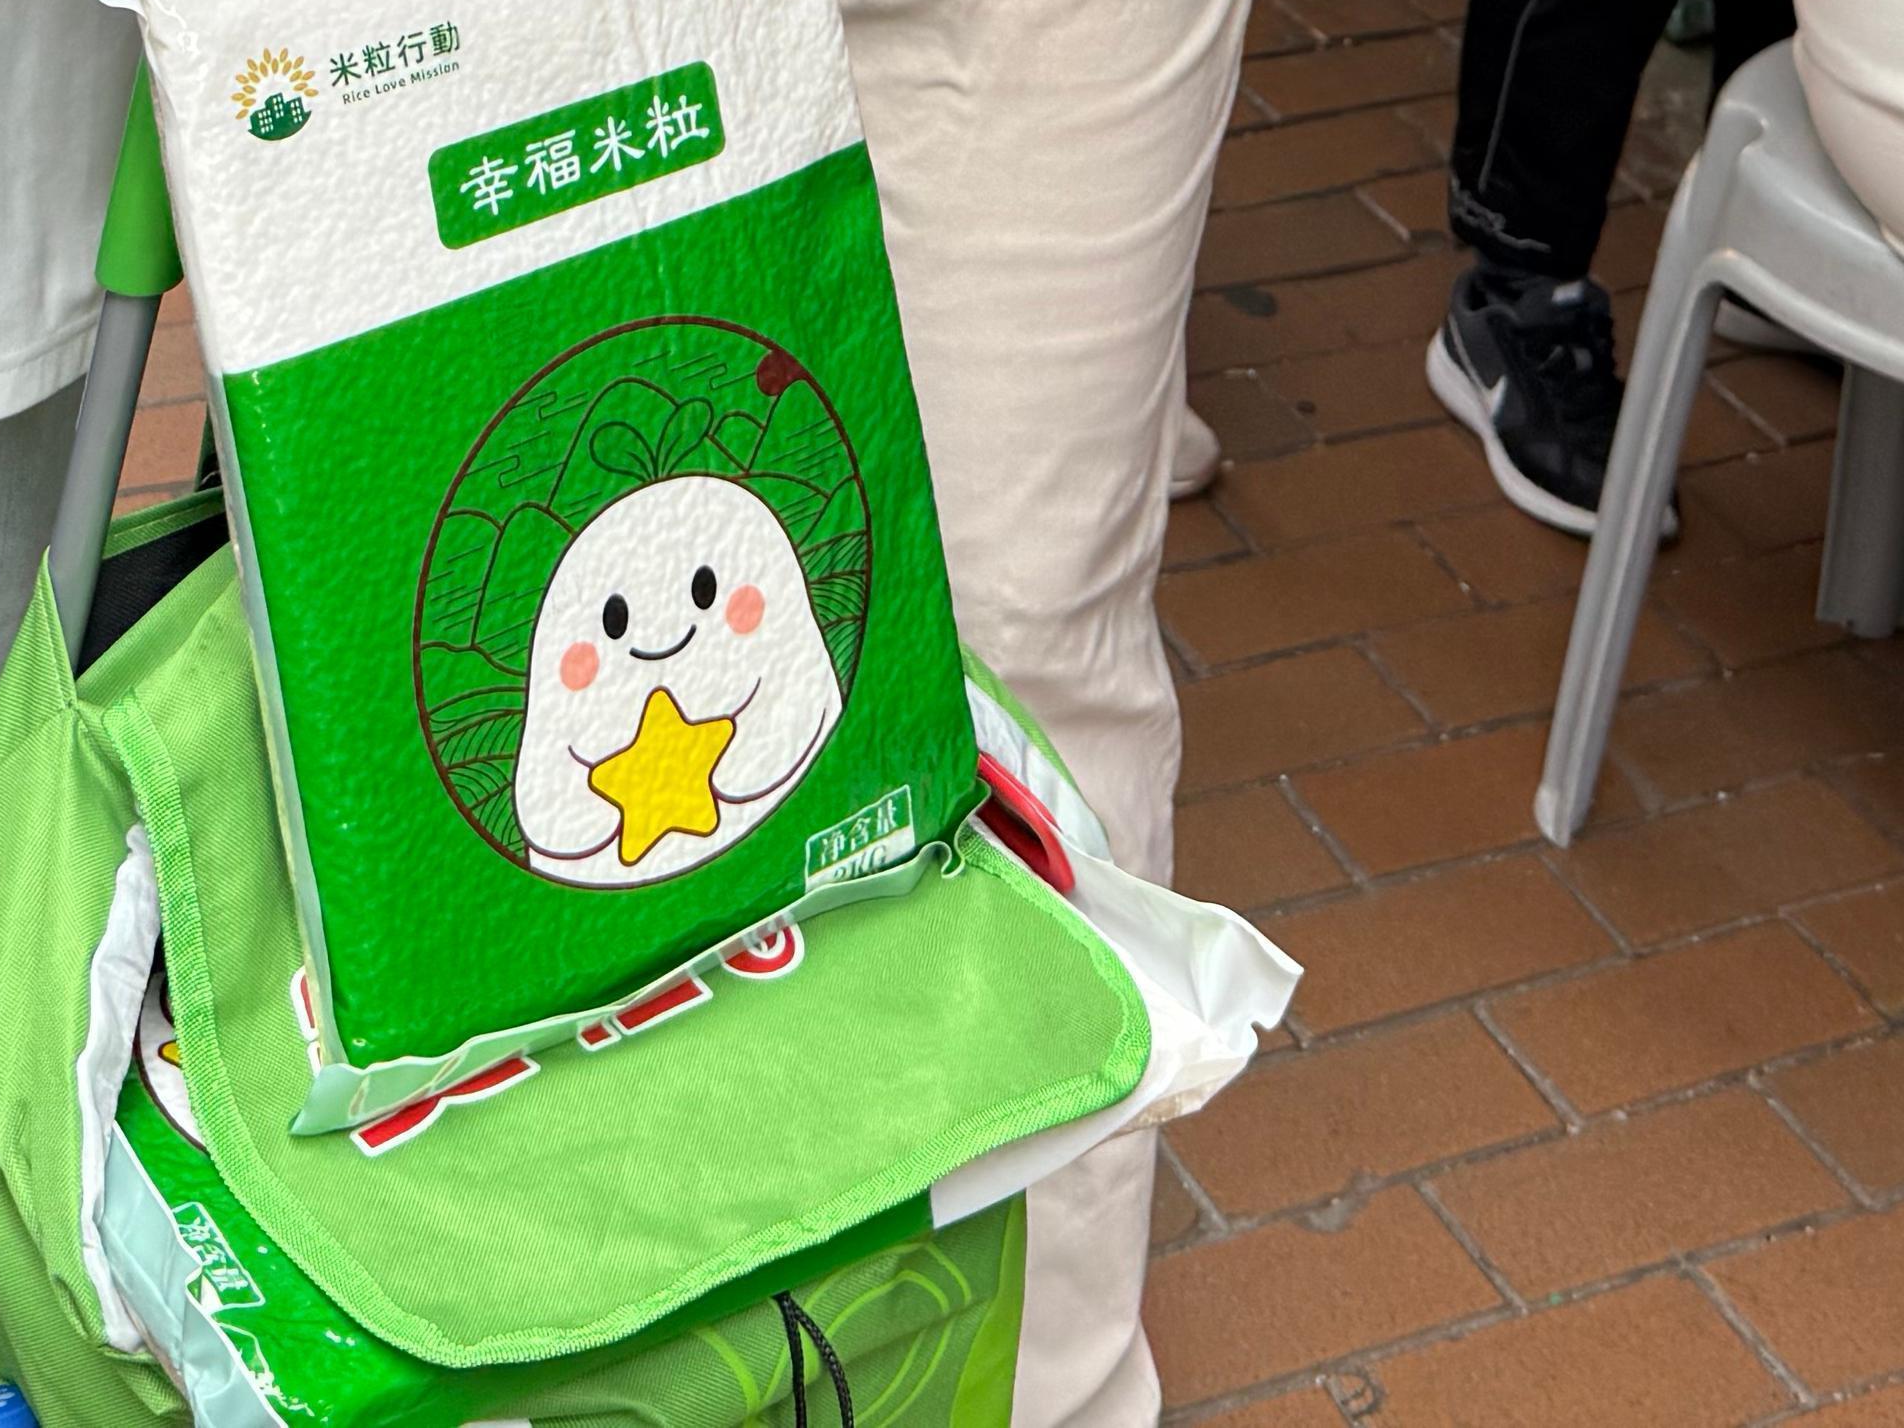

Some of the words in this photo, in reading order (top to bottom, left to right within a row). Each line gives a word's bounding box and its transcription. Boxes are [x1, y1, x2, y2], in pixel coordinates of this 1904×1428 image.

[329, 21, 461, 87] 米粒行動
[342, 89, 371, 105] Rice
[375, 79, 407, 95] Love
[411, 61, 460, 84] Mission
[460, 92, 711, 216] 幸福米粒
